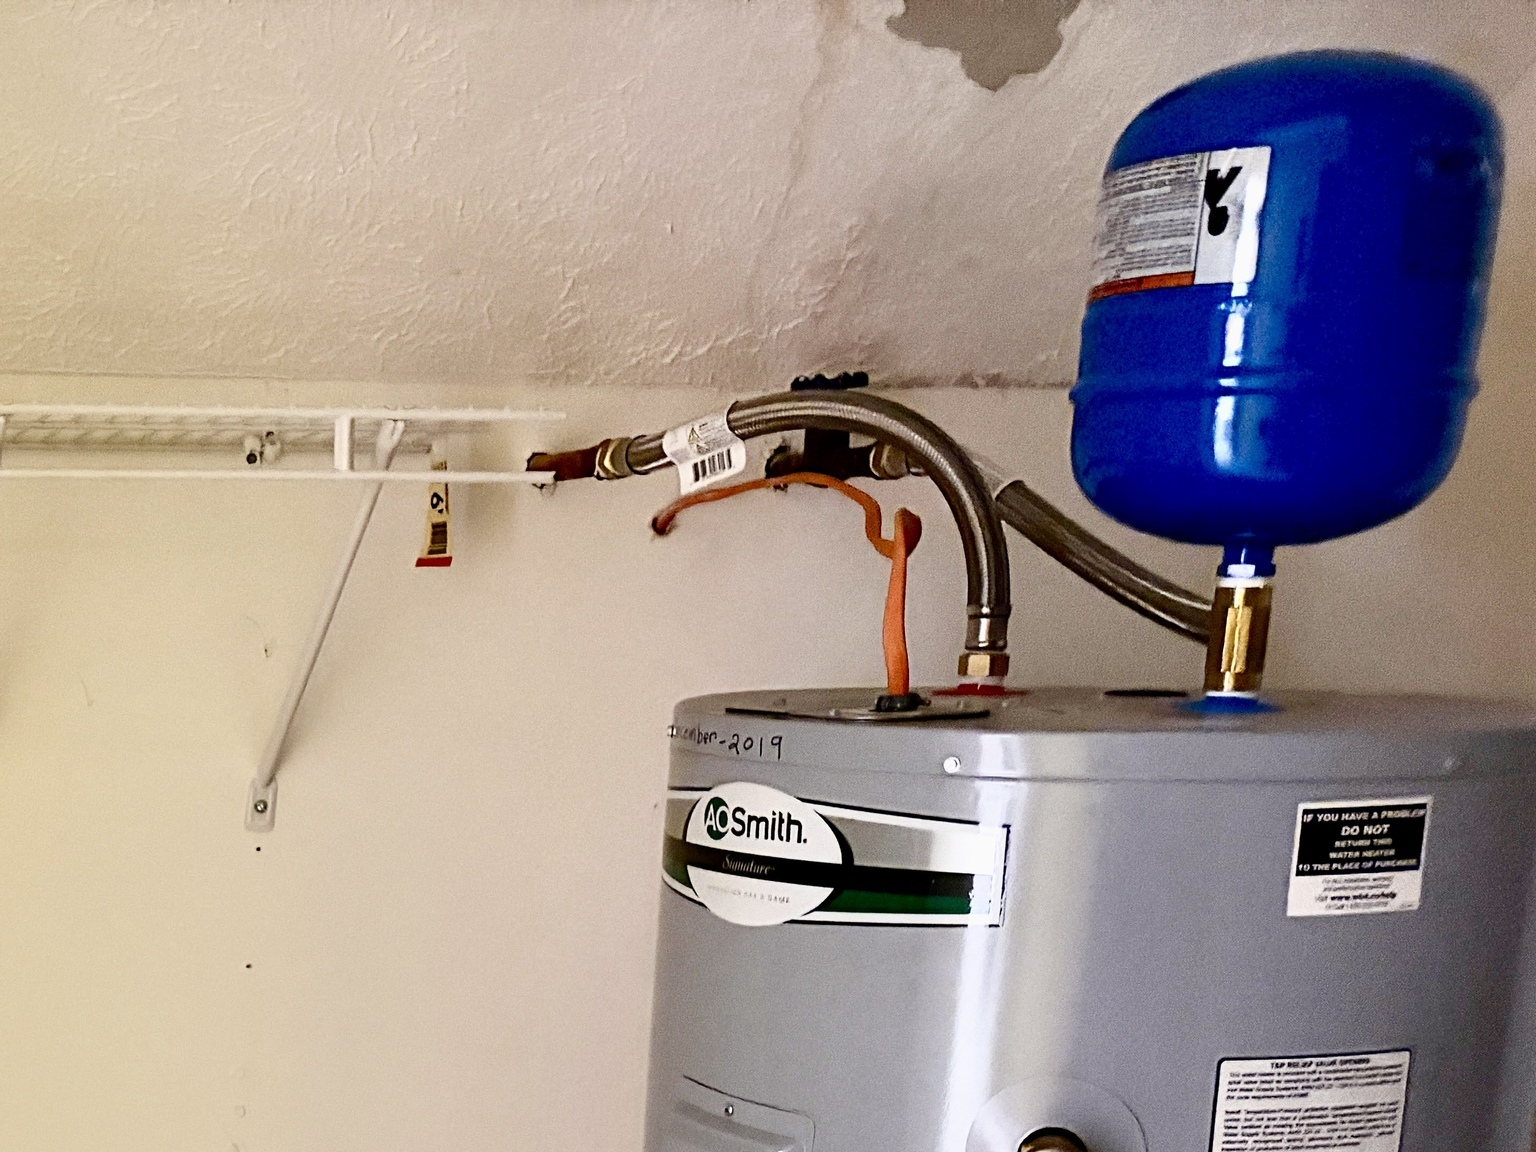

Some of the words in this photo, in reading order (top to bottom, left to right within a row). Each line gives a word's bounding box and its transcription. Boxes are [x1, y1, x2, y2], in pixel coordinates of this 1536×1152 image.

[1303, 814, 1314, 822] IF
[1317, 813, 1339, 822] YOU
[1341, 812, 1369, 820] HAVE
[1341, 825, 1360, 836] DO
[1363, 824, 1390, 835] NOT
[1334, 839, 1371, 848] RETURN
[1329, 851, 1360, 859] WATER
[1362, 849, 1395, 858] HEATER
[1312, 863, 1330, 871] THE
[1331, 862, 1359, 870] PLACE
[1361, 860, 1373, 868] OF
